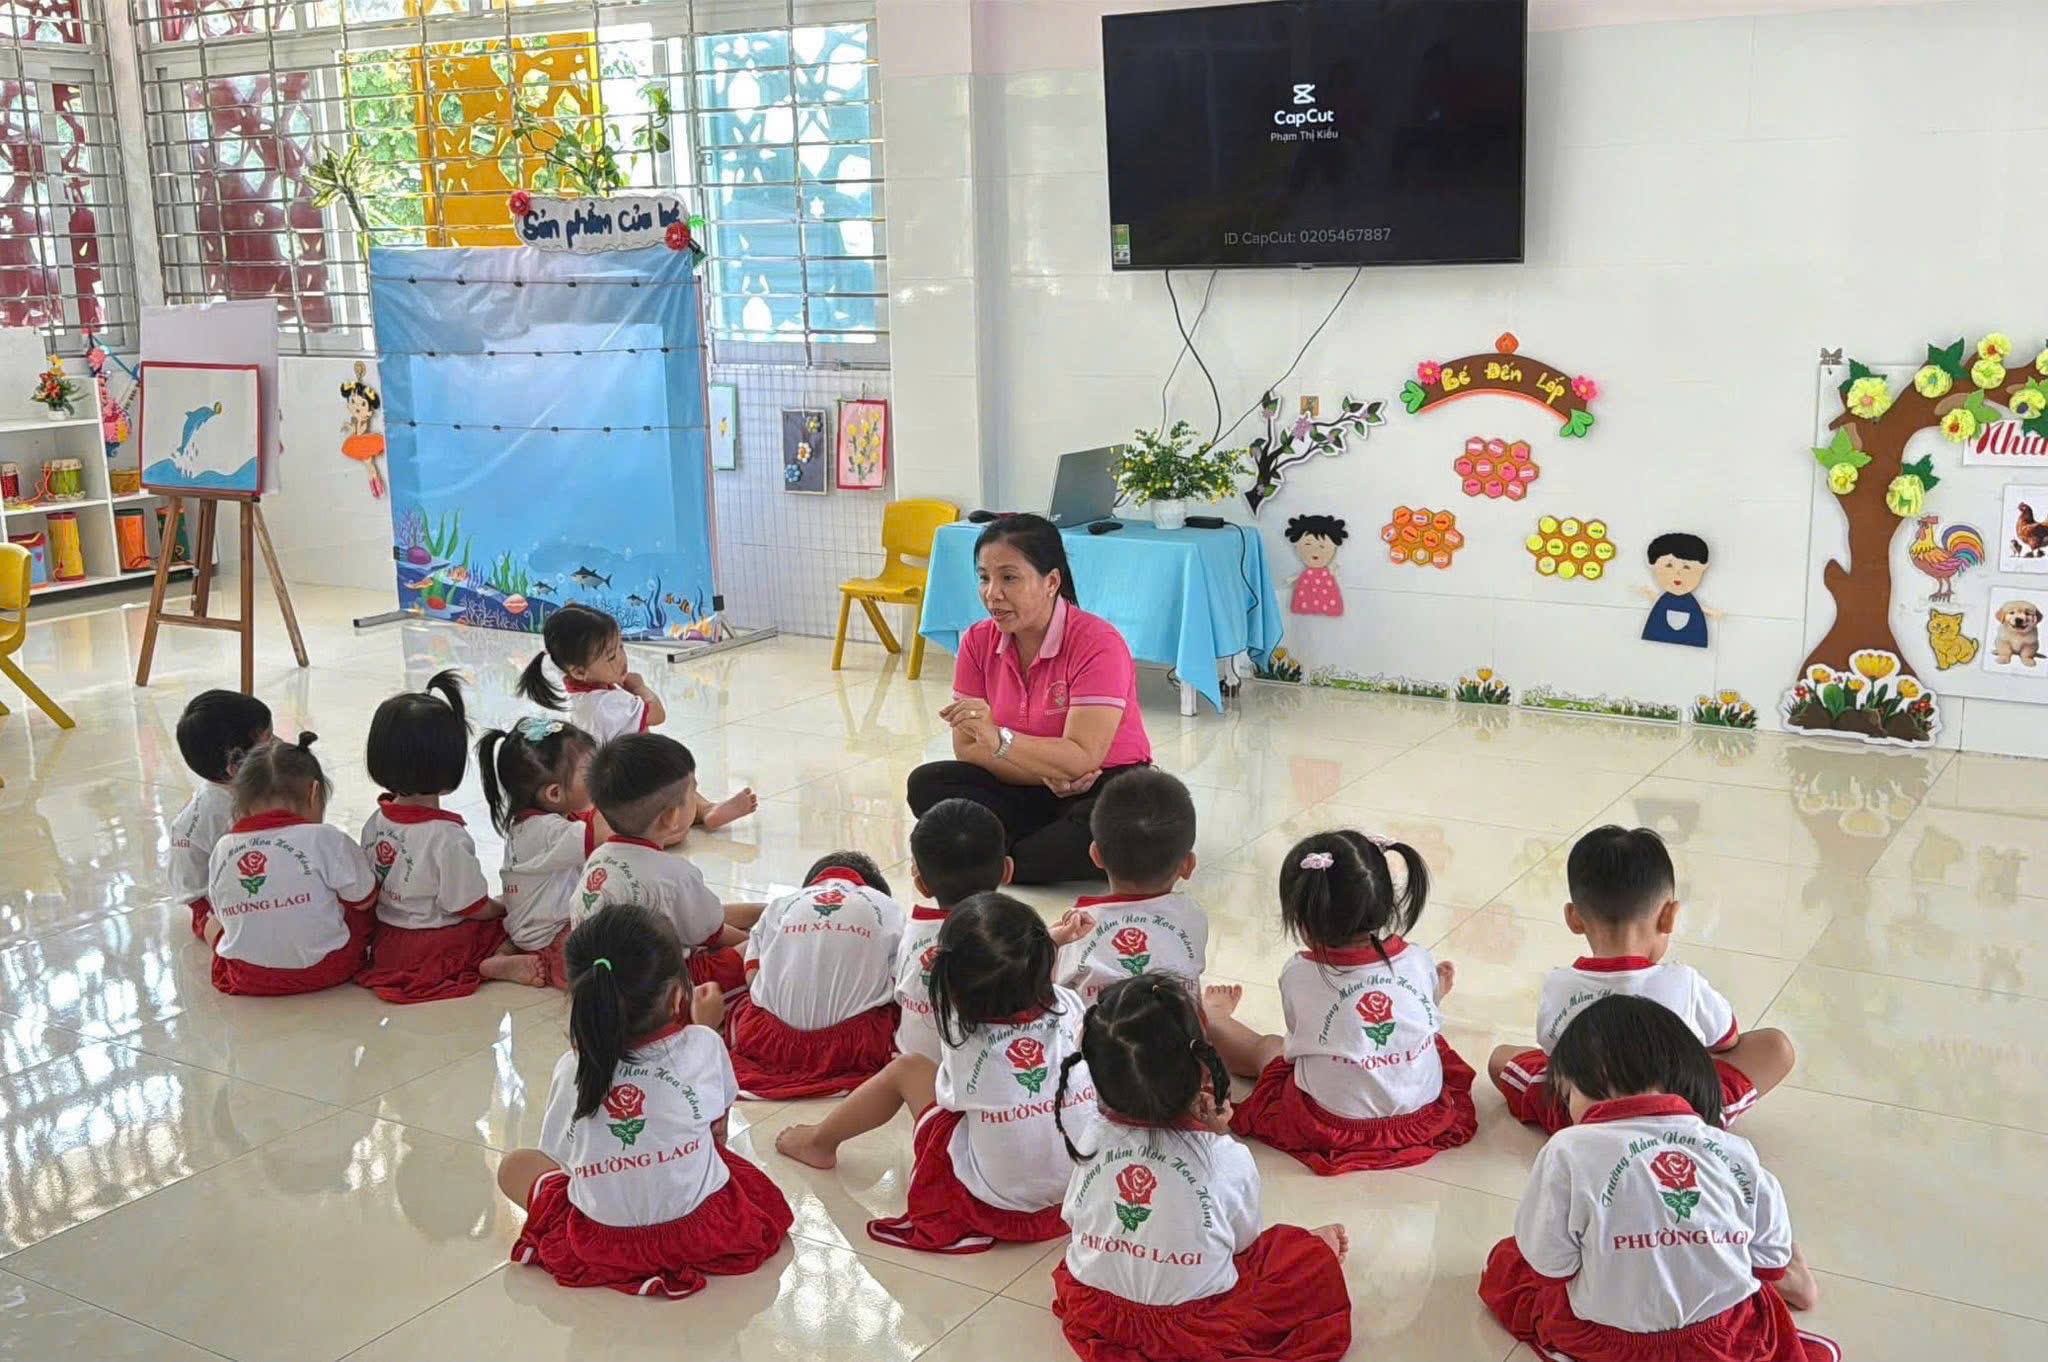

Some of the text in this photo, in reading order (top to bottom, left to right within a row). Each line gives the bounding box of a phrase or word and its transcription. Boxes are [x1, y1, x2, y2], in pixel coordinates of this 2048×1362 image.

[1274, 108, 1335, 127] CapCut
[1224, 228, 1391, 248] ID CapCut: 0205467887
[1440, 361, 1565, 404] Bé Đến Lớp
[273, 893, 311, 908] LAGI
[835, 924, 871, 939] LAGI
[981, 1086, 1096, 1123] PHƯỜNG LAGI
[575, 1139, 699, 1178] PHƯỜNG LAGI
[1170, 1156, 1197, 1185] Hoa
[1602, 1155, 1629, 1207] Trường
[1662, 1131, 1696, 1146] Non
[1703, 1138, 1729, 1163] Hoa
[1081, 1232, 1202, 1265] PHƯỜNG LAGI
[1613, 1228, 1707, 1249] PHƯỜNG
